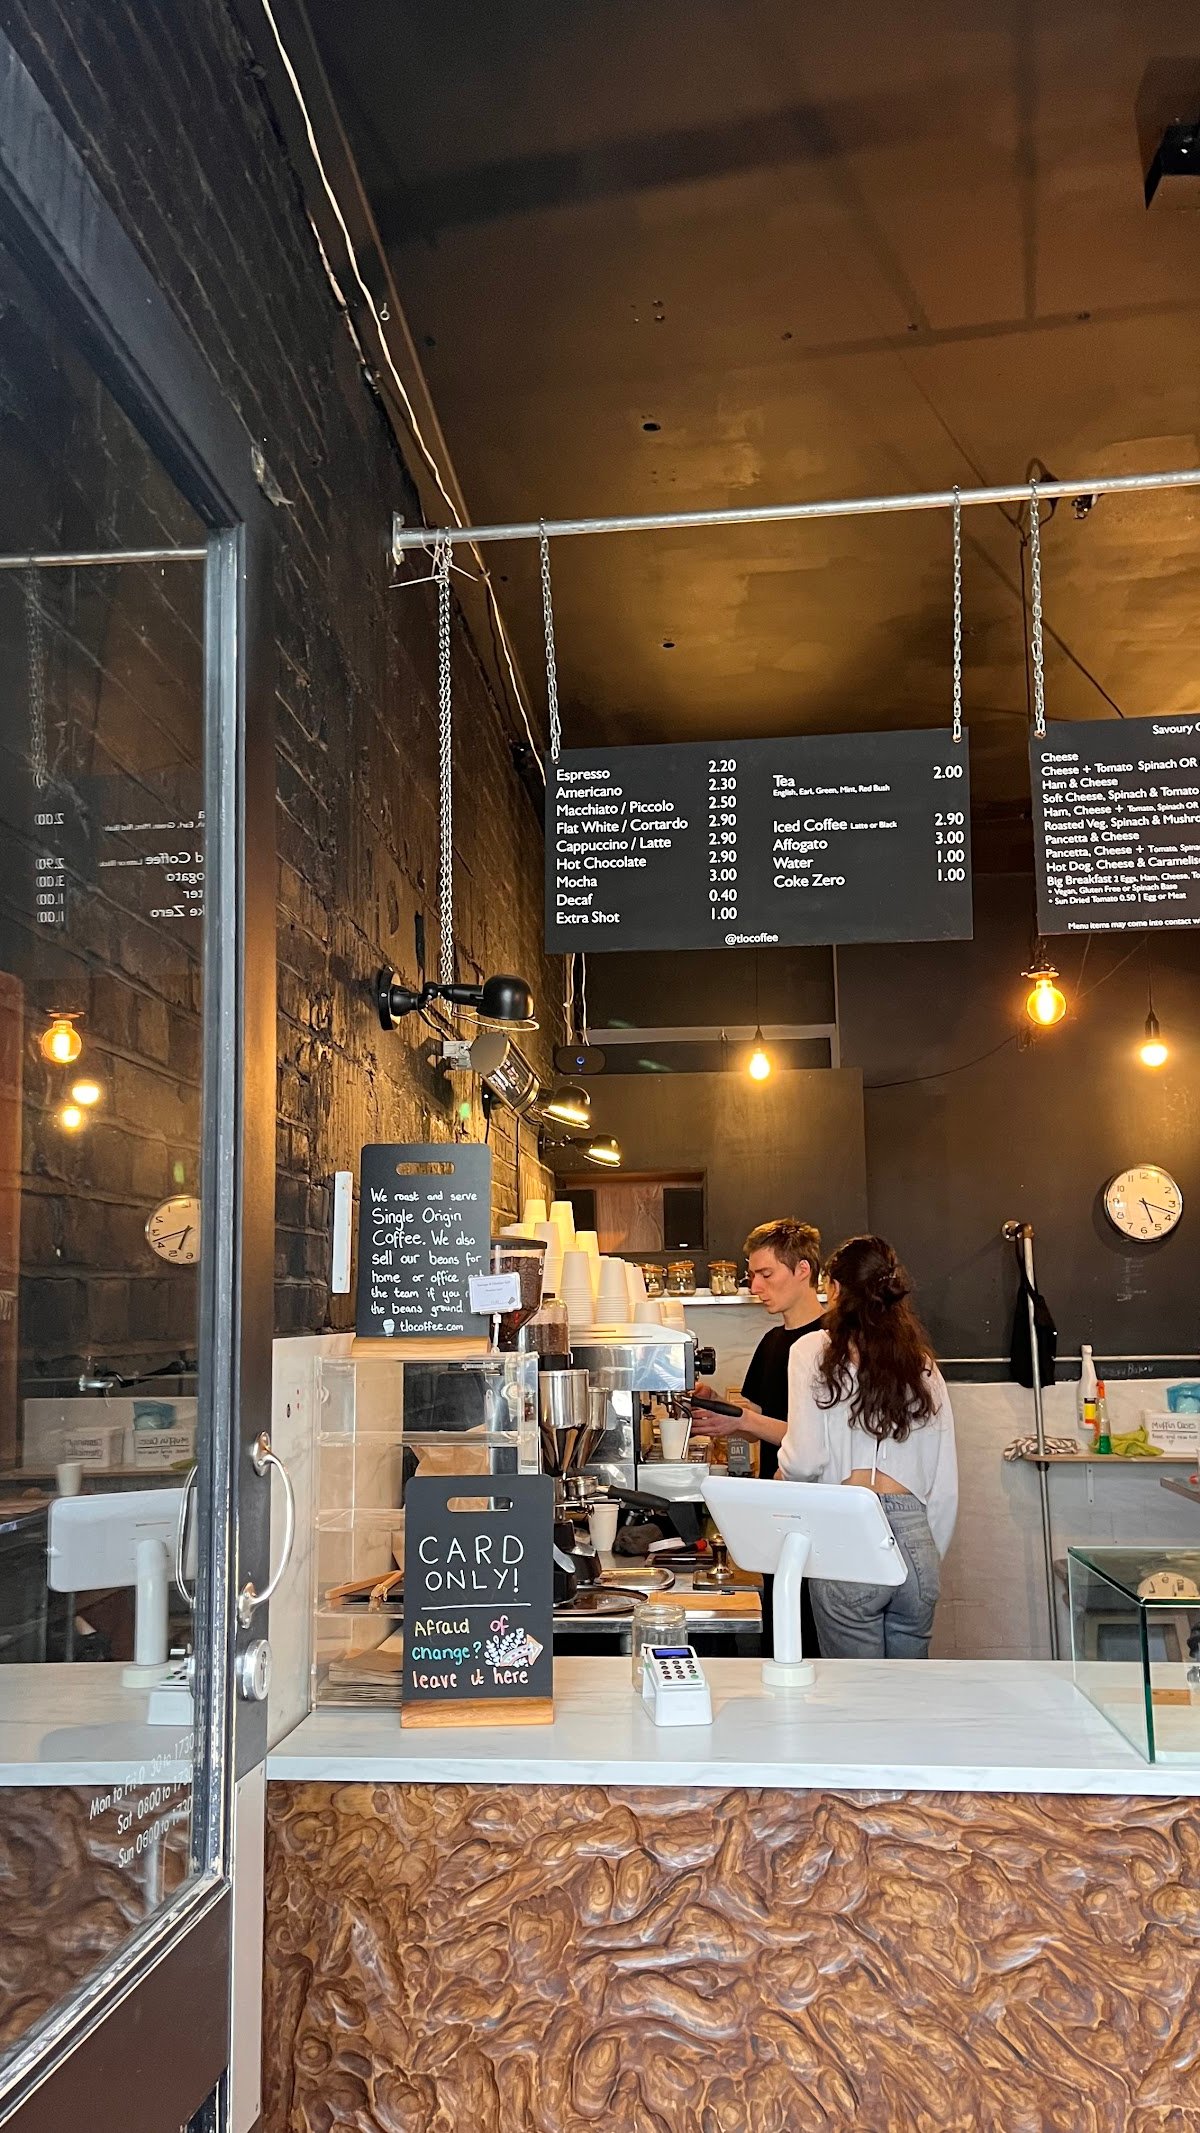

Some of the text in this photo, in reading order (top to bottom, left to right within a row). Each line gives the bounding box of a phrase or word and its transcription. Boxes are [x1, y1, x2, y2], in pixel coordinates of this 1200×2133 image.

[1152, 725, 1193, 735] Savoury
[1041, 753, 1079, 762] Cheese
[708, 759, 736, 772] 2.20
[933, 765, 962, 779] 2.00
[1041, 758, 1198, 776] Cheese Tomato Spinach OR
[556, 769, 610, 783] Espresso
[773, 775, 795, 787] Tea
[708, 778, 736, 790] 2.30
[1042, 777, 1118, 790] Ham & Cheese
[556, 786, 622, 799] Americano
[773, 790, 798, 798] English,
[873, 784, 890, 792] Bush
[1043, 786, 1199, 803] Soft Cheese, Spinach & Tomato
[556, 800, 674, 816] Macchiato Piccolo
[708, 796, 736, 809] 2.50
[1044, 807, 1071, 817] Ham,
[1074, 806, 1111, 815] Cheese
[1157, 803, 1184, 812] Spinach
[1186, 801, 1198, 809] OR
[556, 817, 688, 834] Flat White Cortardo
[708, 814, 736, 827] 2.90
[773, 820, 800, 833] Iced
[804, 818, 847, 831] Coffee
[935, 812, 964, 826] 2.90
[1044, 815, 1160, 831] Roasted Veg, Spinach &
[708, 832, 736, 845] 2.90
[935, 831, 964, 844] 3.00
[1045, 832, 1139, 845] Pancetta & Cheese
[556, 837, 671, 855] Cappuccino Latte
[773, 838, 828, 853] Affogato
[1046, 846, 1132, 858] Pancetta, Cheese
[556, 856, 647, 870] Hot Chocolate
[709, 850, 736, 863] 2.90
[773, 857, 814, 869] Water
[937, 850, 964, 862] 1.00
[1046, 858, 1145, 872] Hot Dog, Cheese &
[709, 868, 737, 881] 3.00
[774, 874, 845, 888] Coke Zero
[938, 868, 965, 881] 1.00
[1047, 876, 1063, 888] Big
[1065, 874, 1112, 885] Breakfast
[556, 876, 597, 888] Mocha
[1079, 886, 1103, 894] Gluten
[1132, 883, 1159, 893] Spinach
[556, 893, 593, 906] Decaf
[709, 889, 737, 902] 0.40
[1070, 896, 1090, 904] Dried
[1143, 893, 1157, 902] Egg
[556, 911, 620, 924] Extra Shot
[711, 907, 737, 920] 1.00
[1068, 922, 1089, 930] Menu
[1090, 921, 1110, 929] items
[725, 933, 778, 945] @tlocoffee
[371, 1188, 477, 1202] We roast and serve
[372, 1207, 462, 1231] Single Origin
[372, 1229, 475, 1248] Coffee. We also
[372, 1250, 482, 1266] sell our beans for
[372, 1270, 401, 1283] home
[412, 1274, 424, 1282] or
[430, 1270, 459, 1286] office
[371, 1286, 388, 1298] the
[394, 1287, 419, 1298] team
[426, 1287, 435, 1301] if
[443, 1291, 460, 1303] you
[371, 1300, 463, 1317] the beans ground
[400, 1319, 463, 1332] tlocoffee.com
[419, 1535, 524, 1564] CARD
[426, 1568, 518, 1593] ONLY!
[415, 1615, 509, 1637] Afraid of
[412, 1641, 482, 1665] change?
[412, 1668, 528, 1689] leave it here
[90, 1795, 110, 1820] Mon
[114, 1788, 122, 1803] to
[174, 1732, 194, 1759] 1730
[118, 1811, 132, 1834] Sat
[138, 1788, 160, 1819] 0800
[162, 1786, 170, 1801] to
[119, 1846, 134, 1868] Sun
[137, 1821, 159, 1854] 0800
[161, 1820, 169, 1834] to
